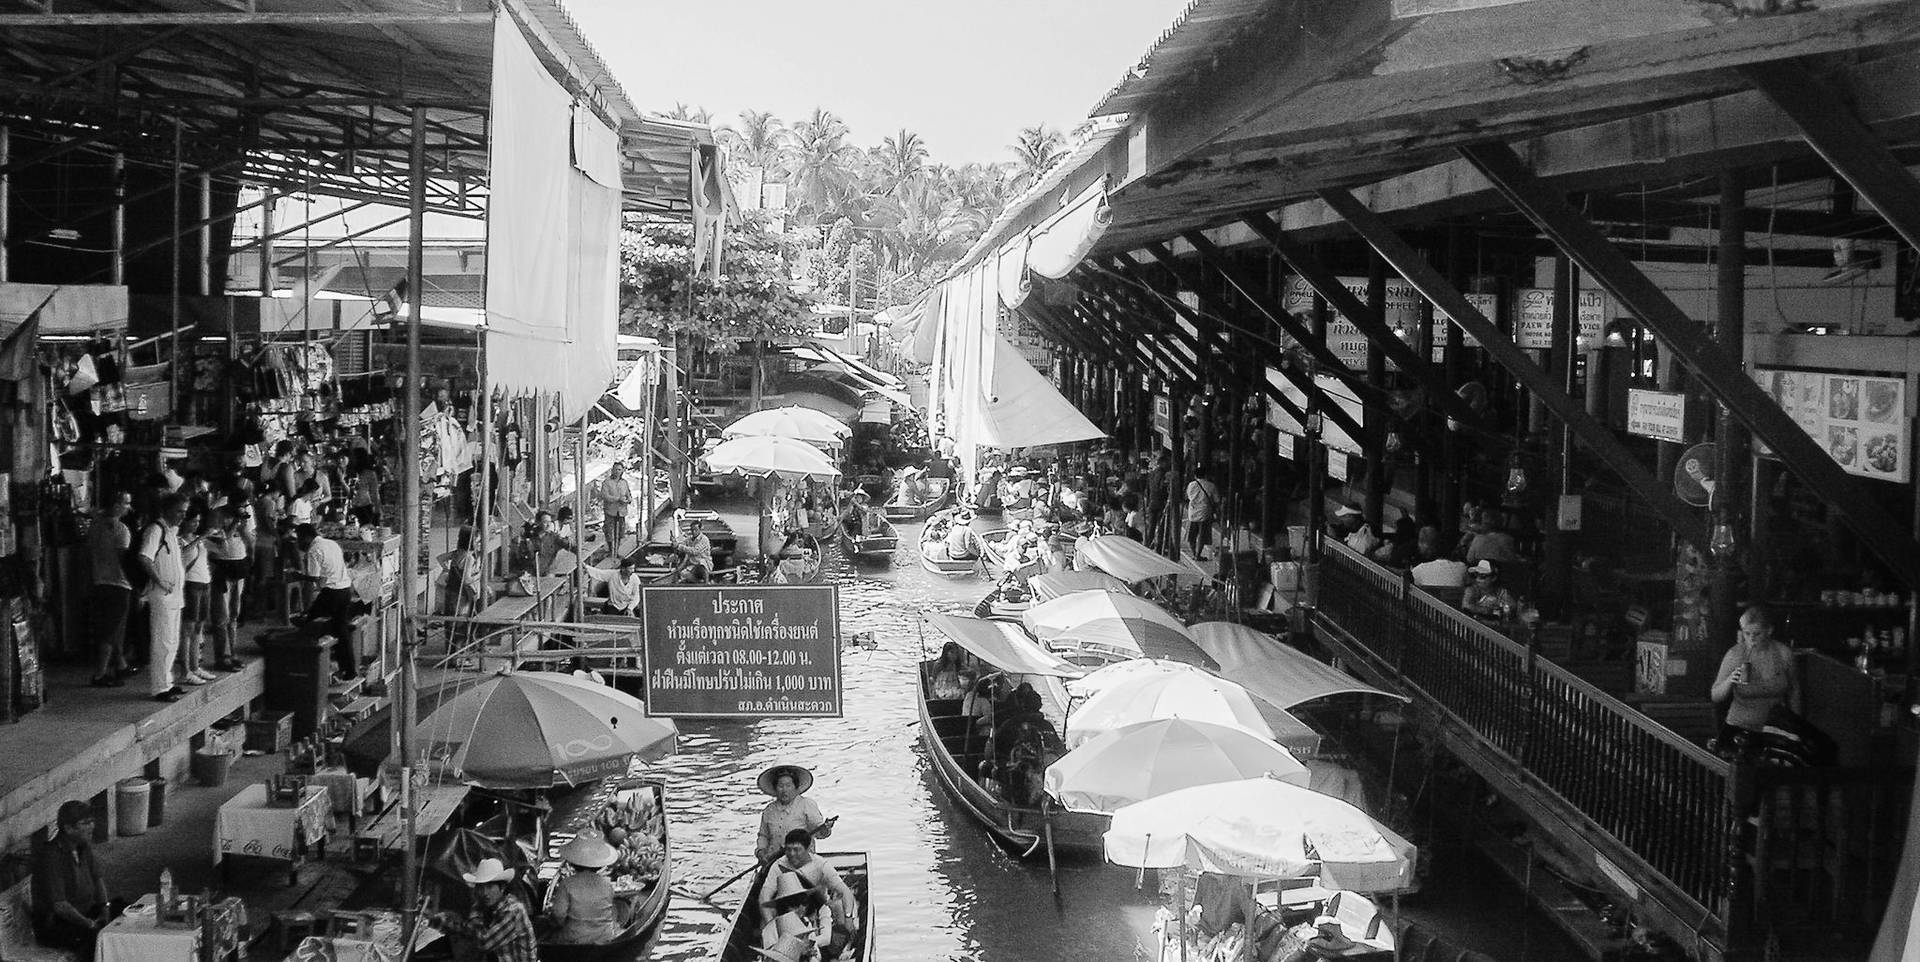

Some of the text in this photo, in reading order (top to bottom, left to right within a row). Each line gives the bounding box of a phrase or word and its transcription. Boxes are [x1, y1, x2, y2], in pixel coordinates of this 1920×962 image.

[711, 591, 764, 615] ประกาศ
[666, 613, 819, 648] ห้ามเรือทุกชนิดใช้เครื่องยนต์
[676, 640, 812, 666] ตั้งแต่เวลา 08.00-12.00 น.
[651, 667, 832, 693] ฝ่าฝืนมีโทษปรับไม่เกิน 1,000 บาท
